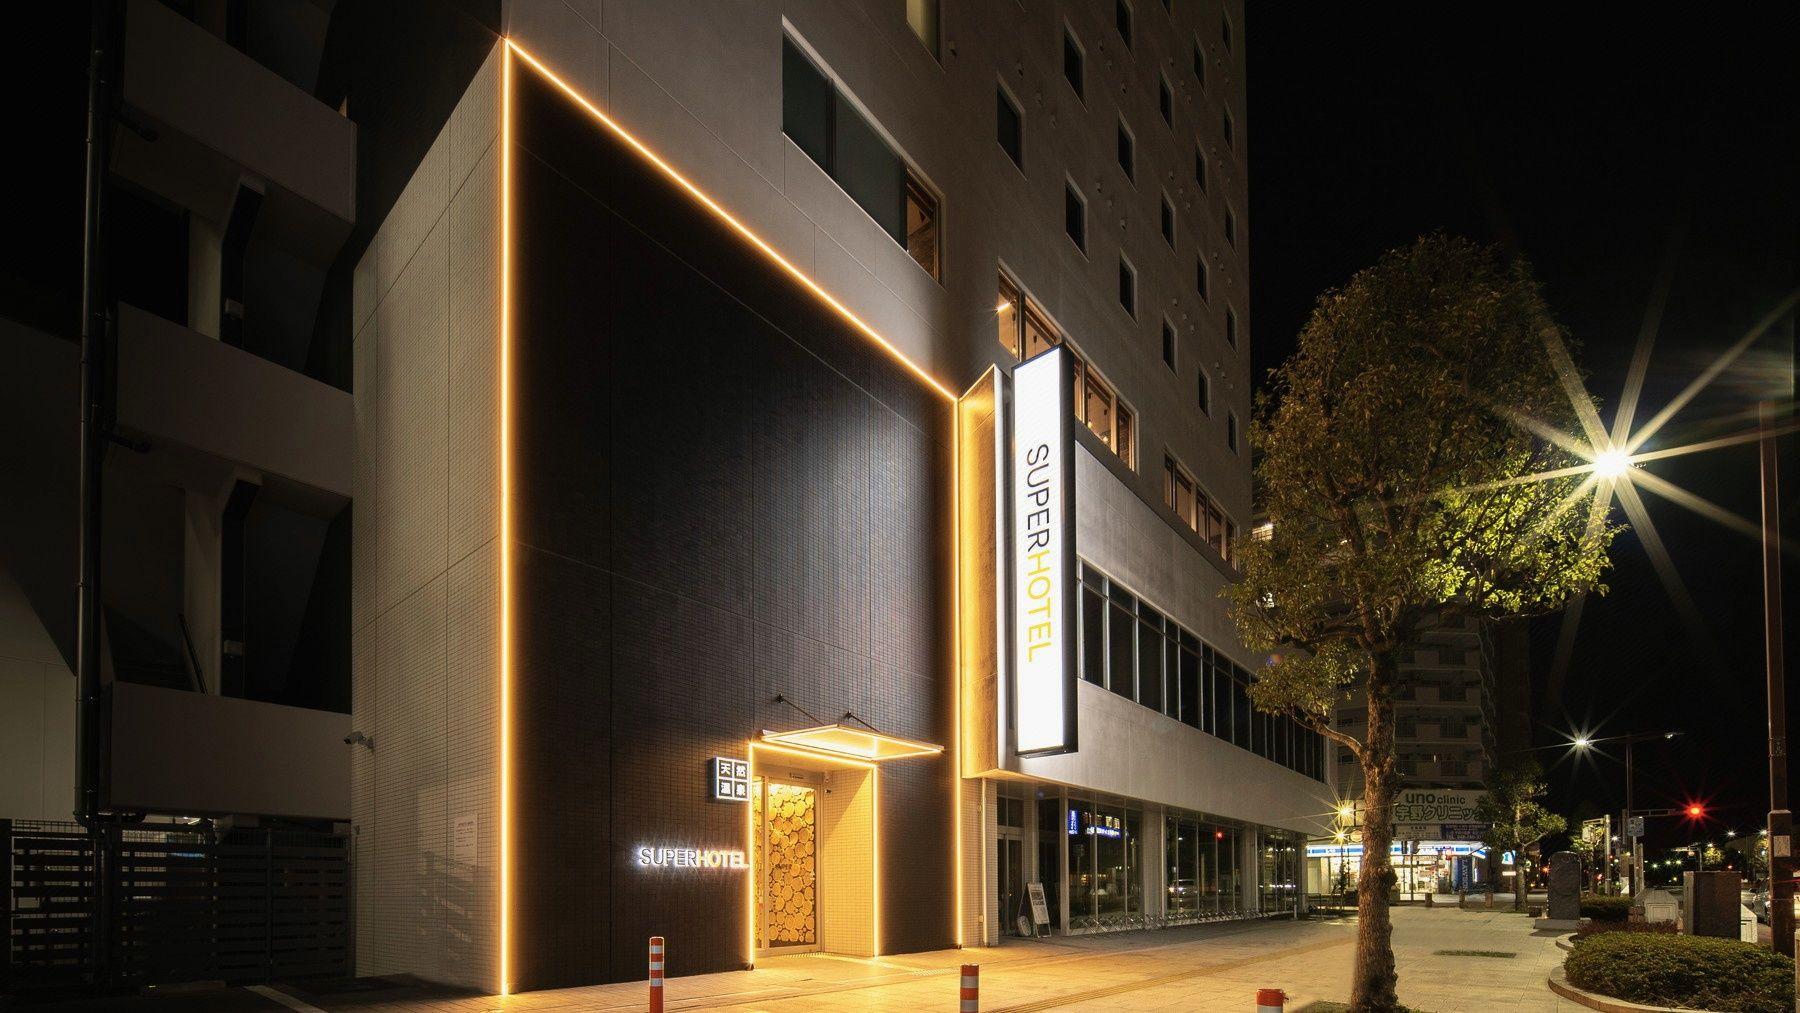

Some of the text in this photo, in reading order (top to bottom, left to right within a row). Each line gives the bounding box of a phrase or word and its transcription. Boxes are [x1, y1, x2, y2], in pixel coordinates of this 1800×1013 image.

[1027, 443, 1052, 663] SUPERHOTEL
[720, 762, 746, 777] 天然
[1405, 793, 1466, 804] uno clinic
[641, 848, 750, 867] SUPERHOTEL
